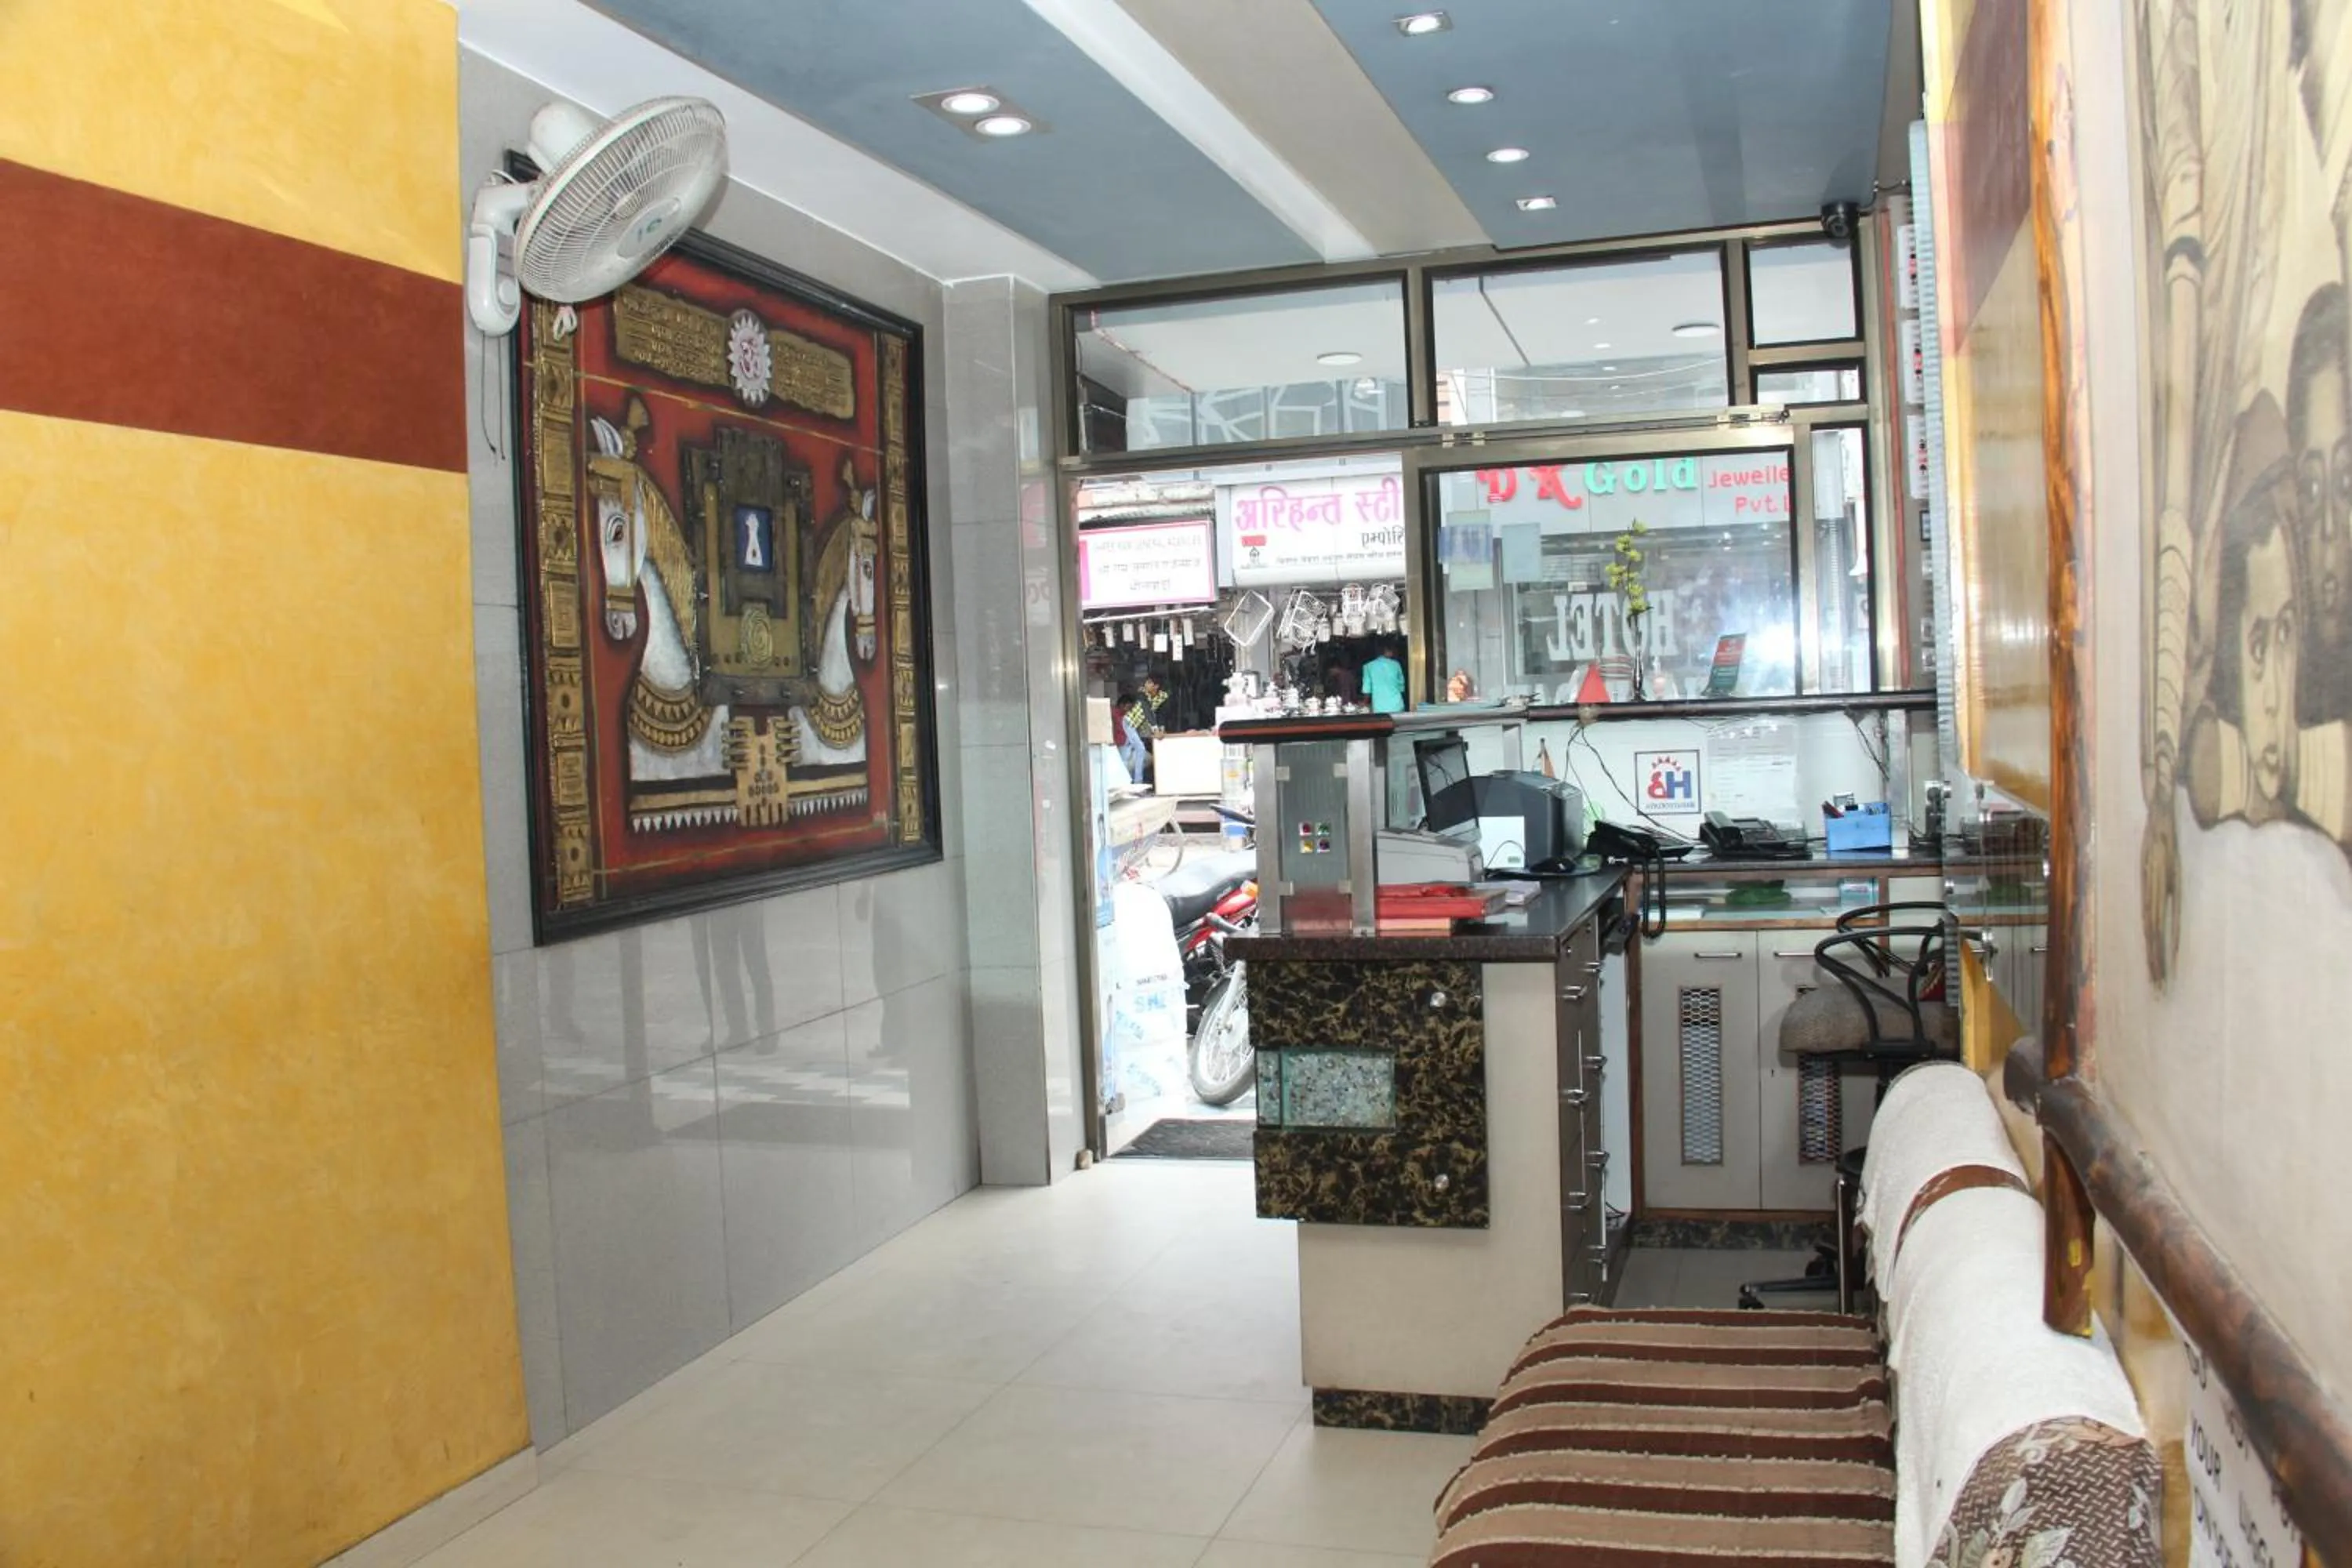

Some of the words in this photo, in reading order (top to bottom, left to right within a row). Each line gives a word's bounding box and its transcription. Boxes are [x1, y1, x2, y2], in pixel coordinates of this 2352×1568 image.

[1584, 457, 1698, 495] Gold
[1236, 485, 1344, 532] अरिहन्त
[2190, 1411, 2221, 1492] YOUR
